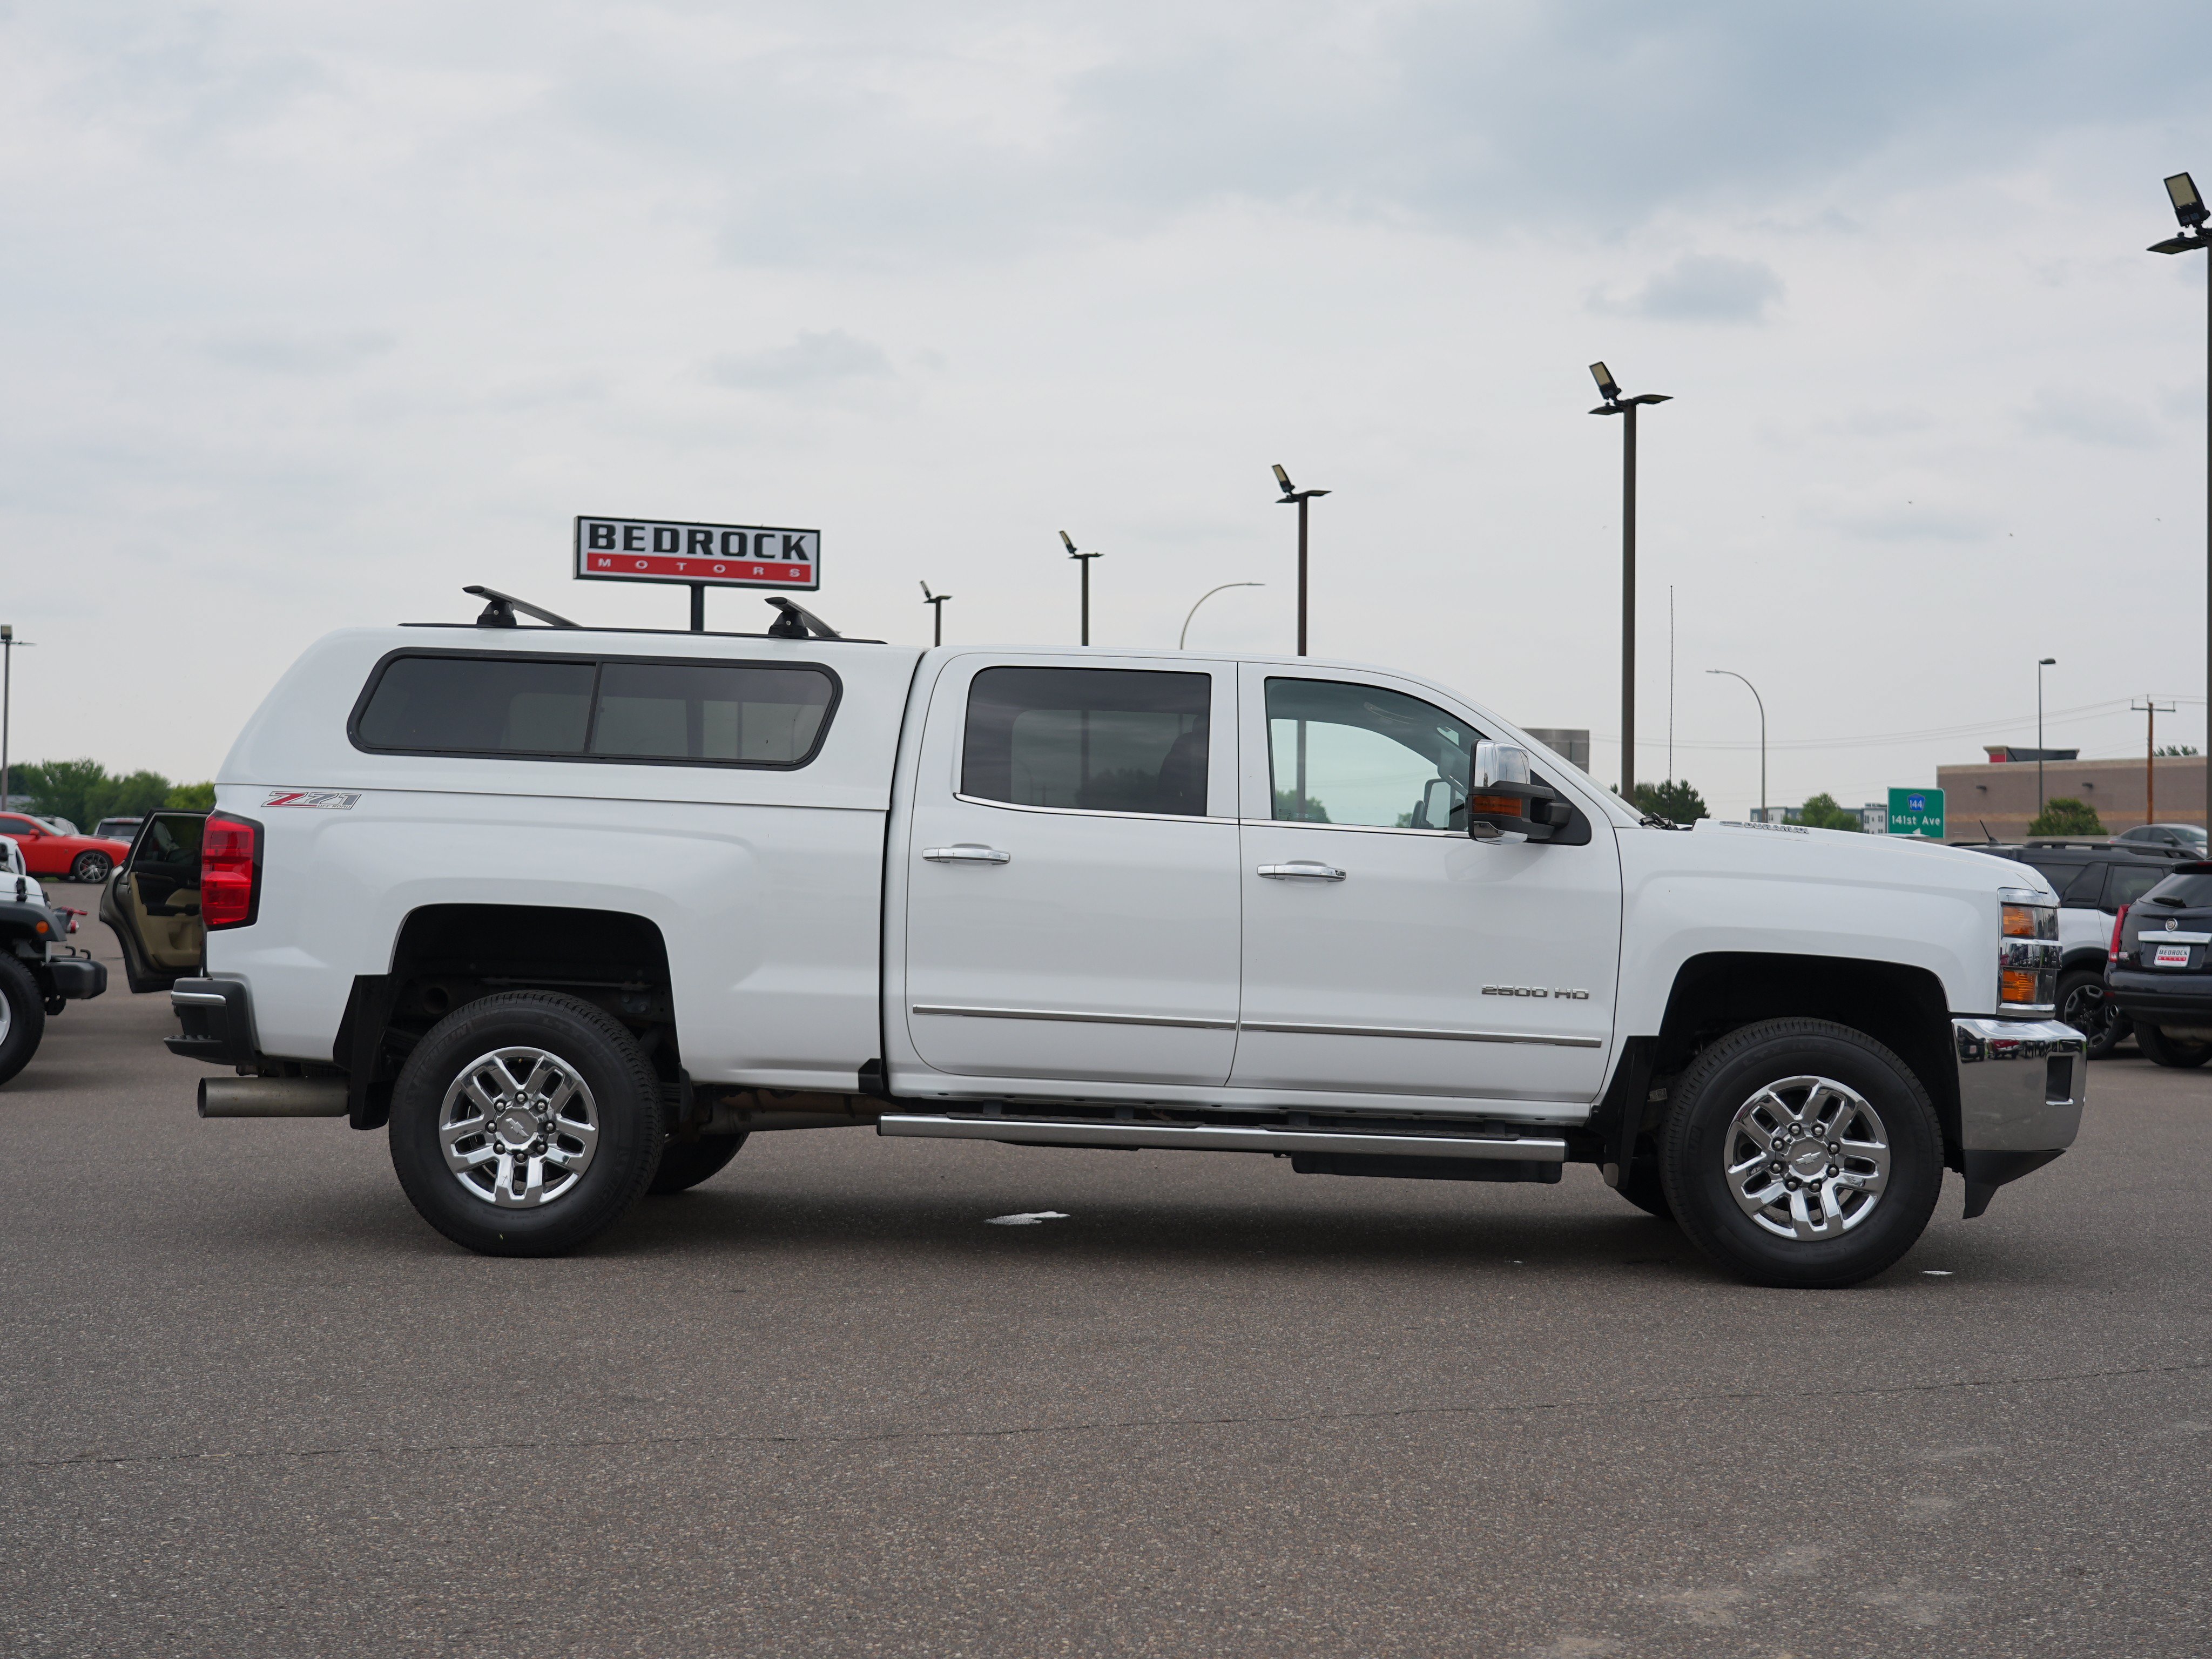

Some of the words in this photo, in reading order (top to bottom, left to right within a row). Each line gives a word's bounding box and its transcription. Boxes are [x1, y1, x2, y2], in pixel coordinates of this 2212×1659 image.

[589, 523, 810, 561] BEDROCK
[598, 558, 800, 578] MOTORS
[261, 791, 362, 809] Z71
[1910, 799, 1923, 808] 144
[1892, 814, 1917, 825] 141st
[1922, 815, 1940, 826] Ave
[1744, 822, 1809, 834] DURAMAX
[1481, 984, 1548, 997] 2500
[1555, 988, 1589, 999] HD
